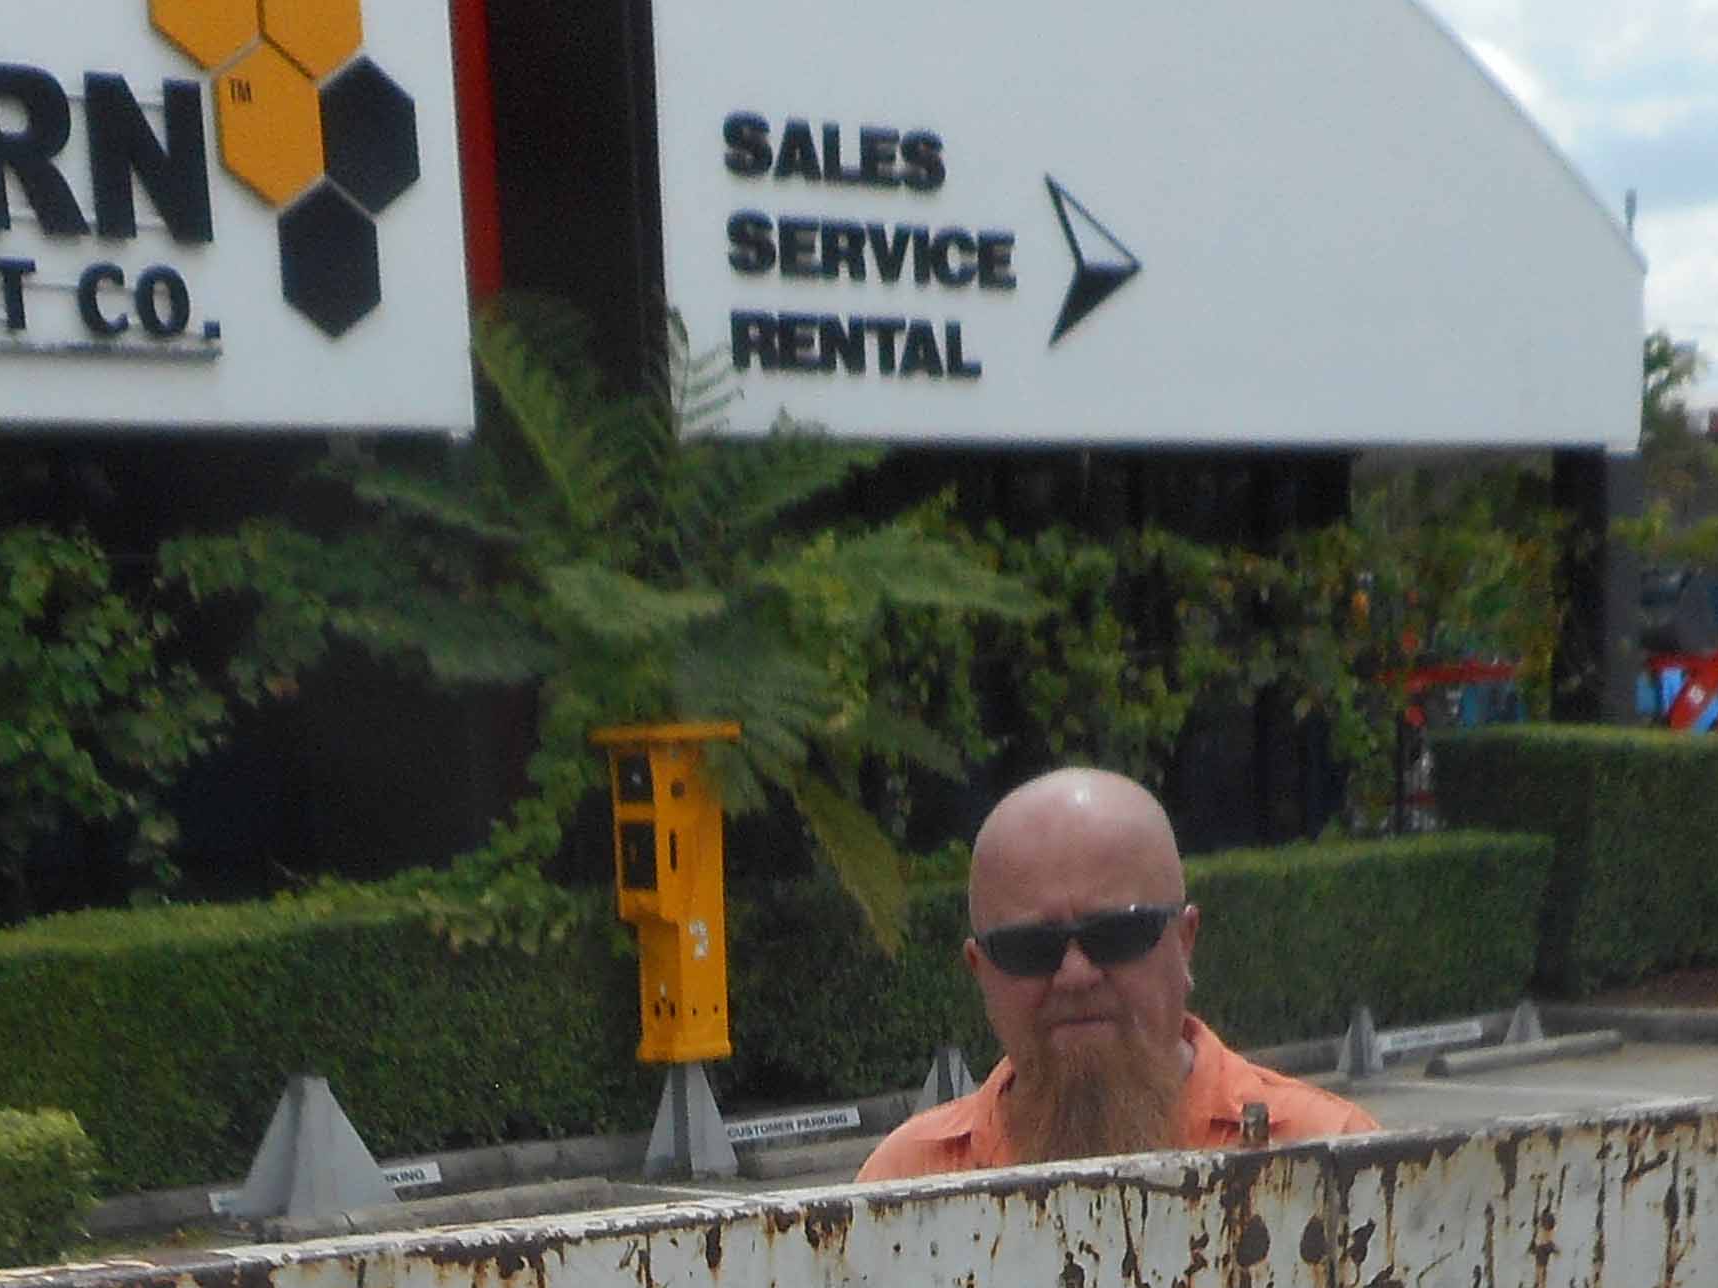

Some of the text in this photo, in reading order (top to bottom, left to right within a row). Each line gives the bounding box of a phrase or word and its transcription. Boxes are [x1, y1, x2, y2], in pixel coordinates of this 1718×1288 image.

[722, 110, 947, 191] SALES
[726, 208, 1017, 290] SERVICE
[77, 261, 222, 339] CO.
[730, 309, 982, 379] RENTAL
[727, 1113, 849, 1138] CUSTOMER PARKING
